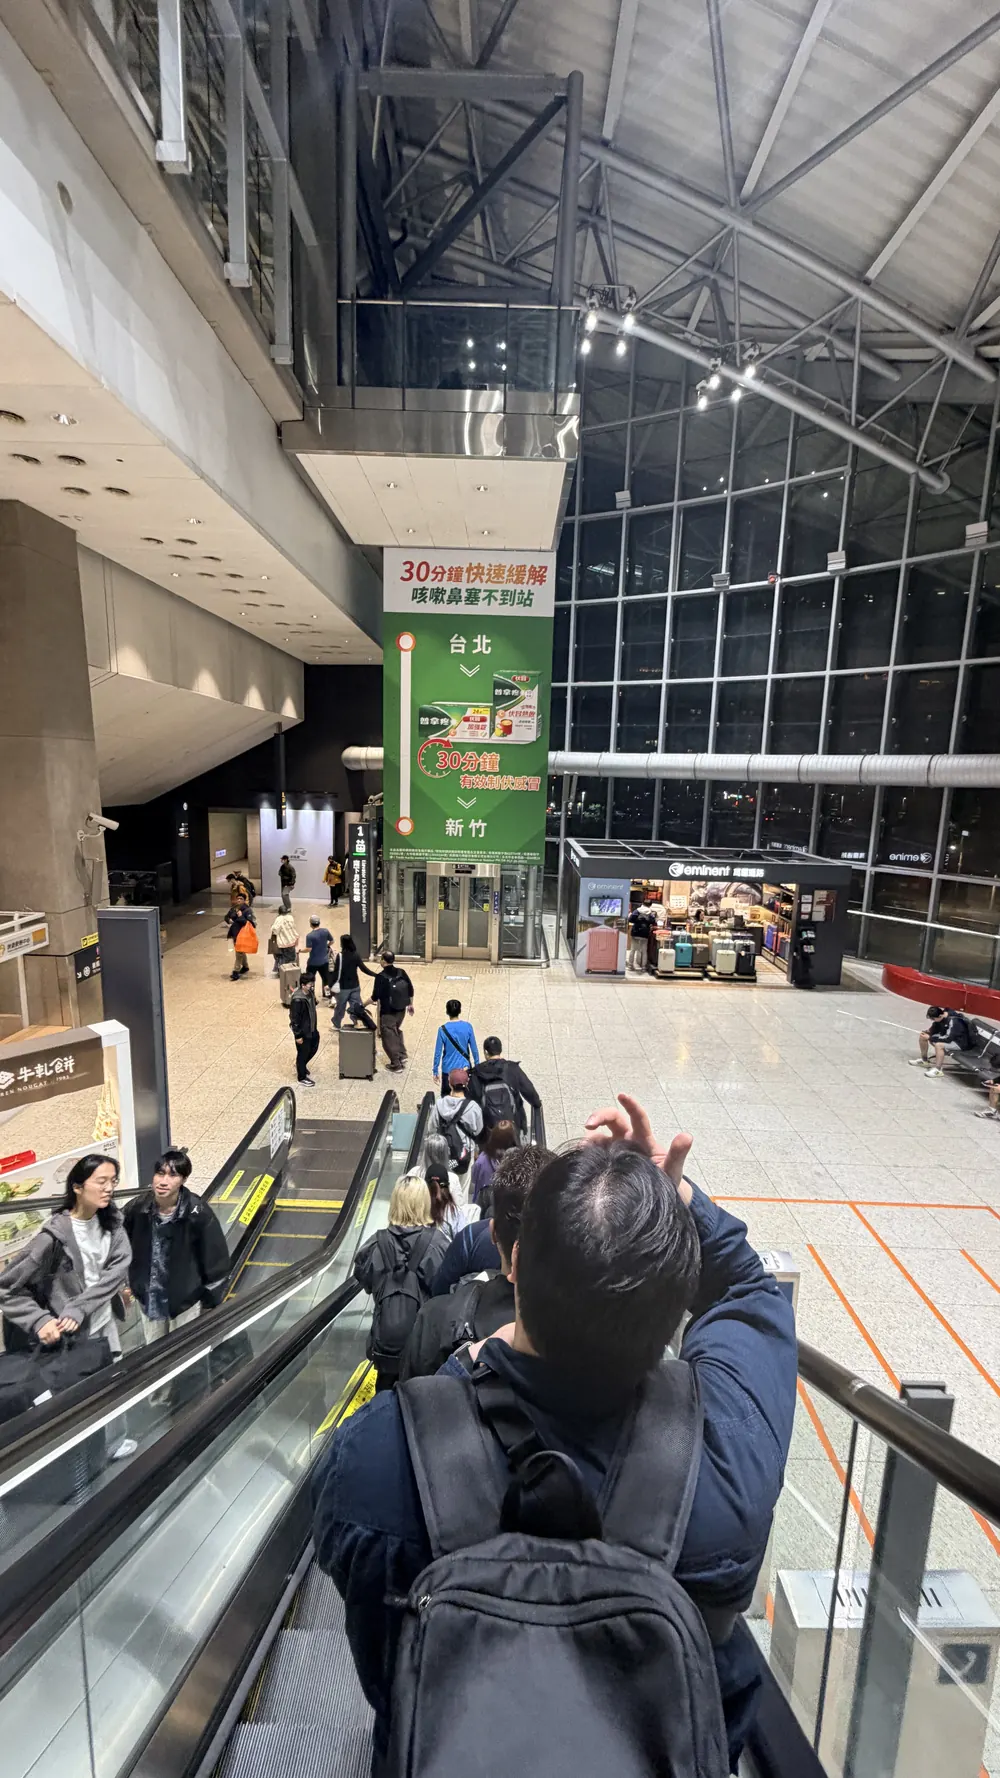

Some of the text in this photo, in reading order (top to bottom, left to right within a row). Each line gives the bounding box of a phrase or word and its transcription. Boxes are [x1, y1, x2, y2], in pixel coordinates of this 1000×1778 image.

[399, 560, 548, 586] 30分鐘快速緩解
[411, 586, 535, 607] 咳嗽鼻塞不到站
[449, 633, 492, 654] 台北
[436, 750, 500, 772] 30分鐘
[460, 775, 541, 791] 有效制伏感冒
[445, 818, 488, 838] 新竹
[684, 864, 731, 877] eminent
[17, 1055, 76, 1082] 牛軋餅
[17, 1080, 48, 1092] NOUGAT
